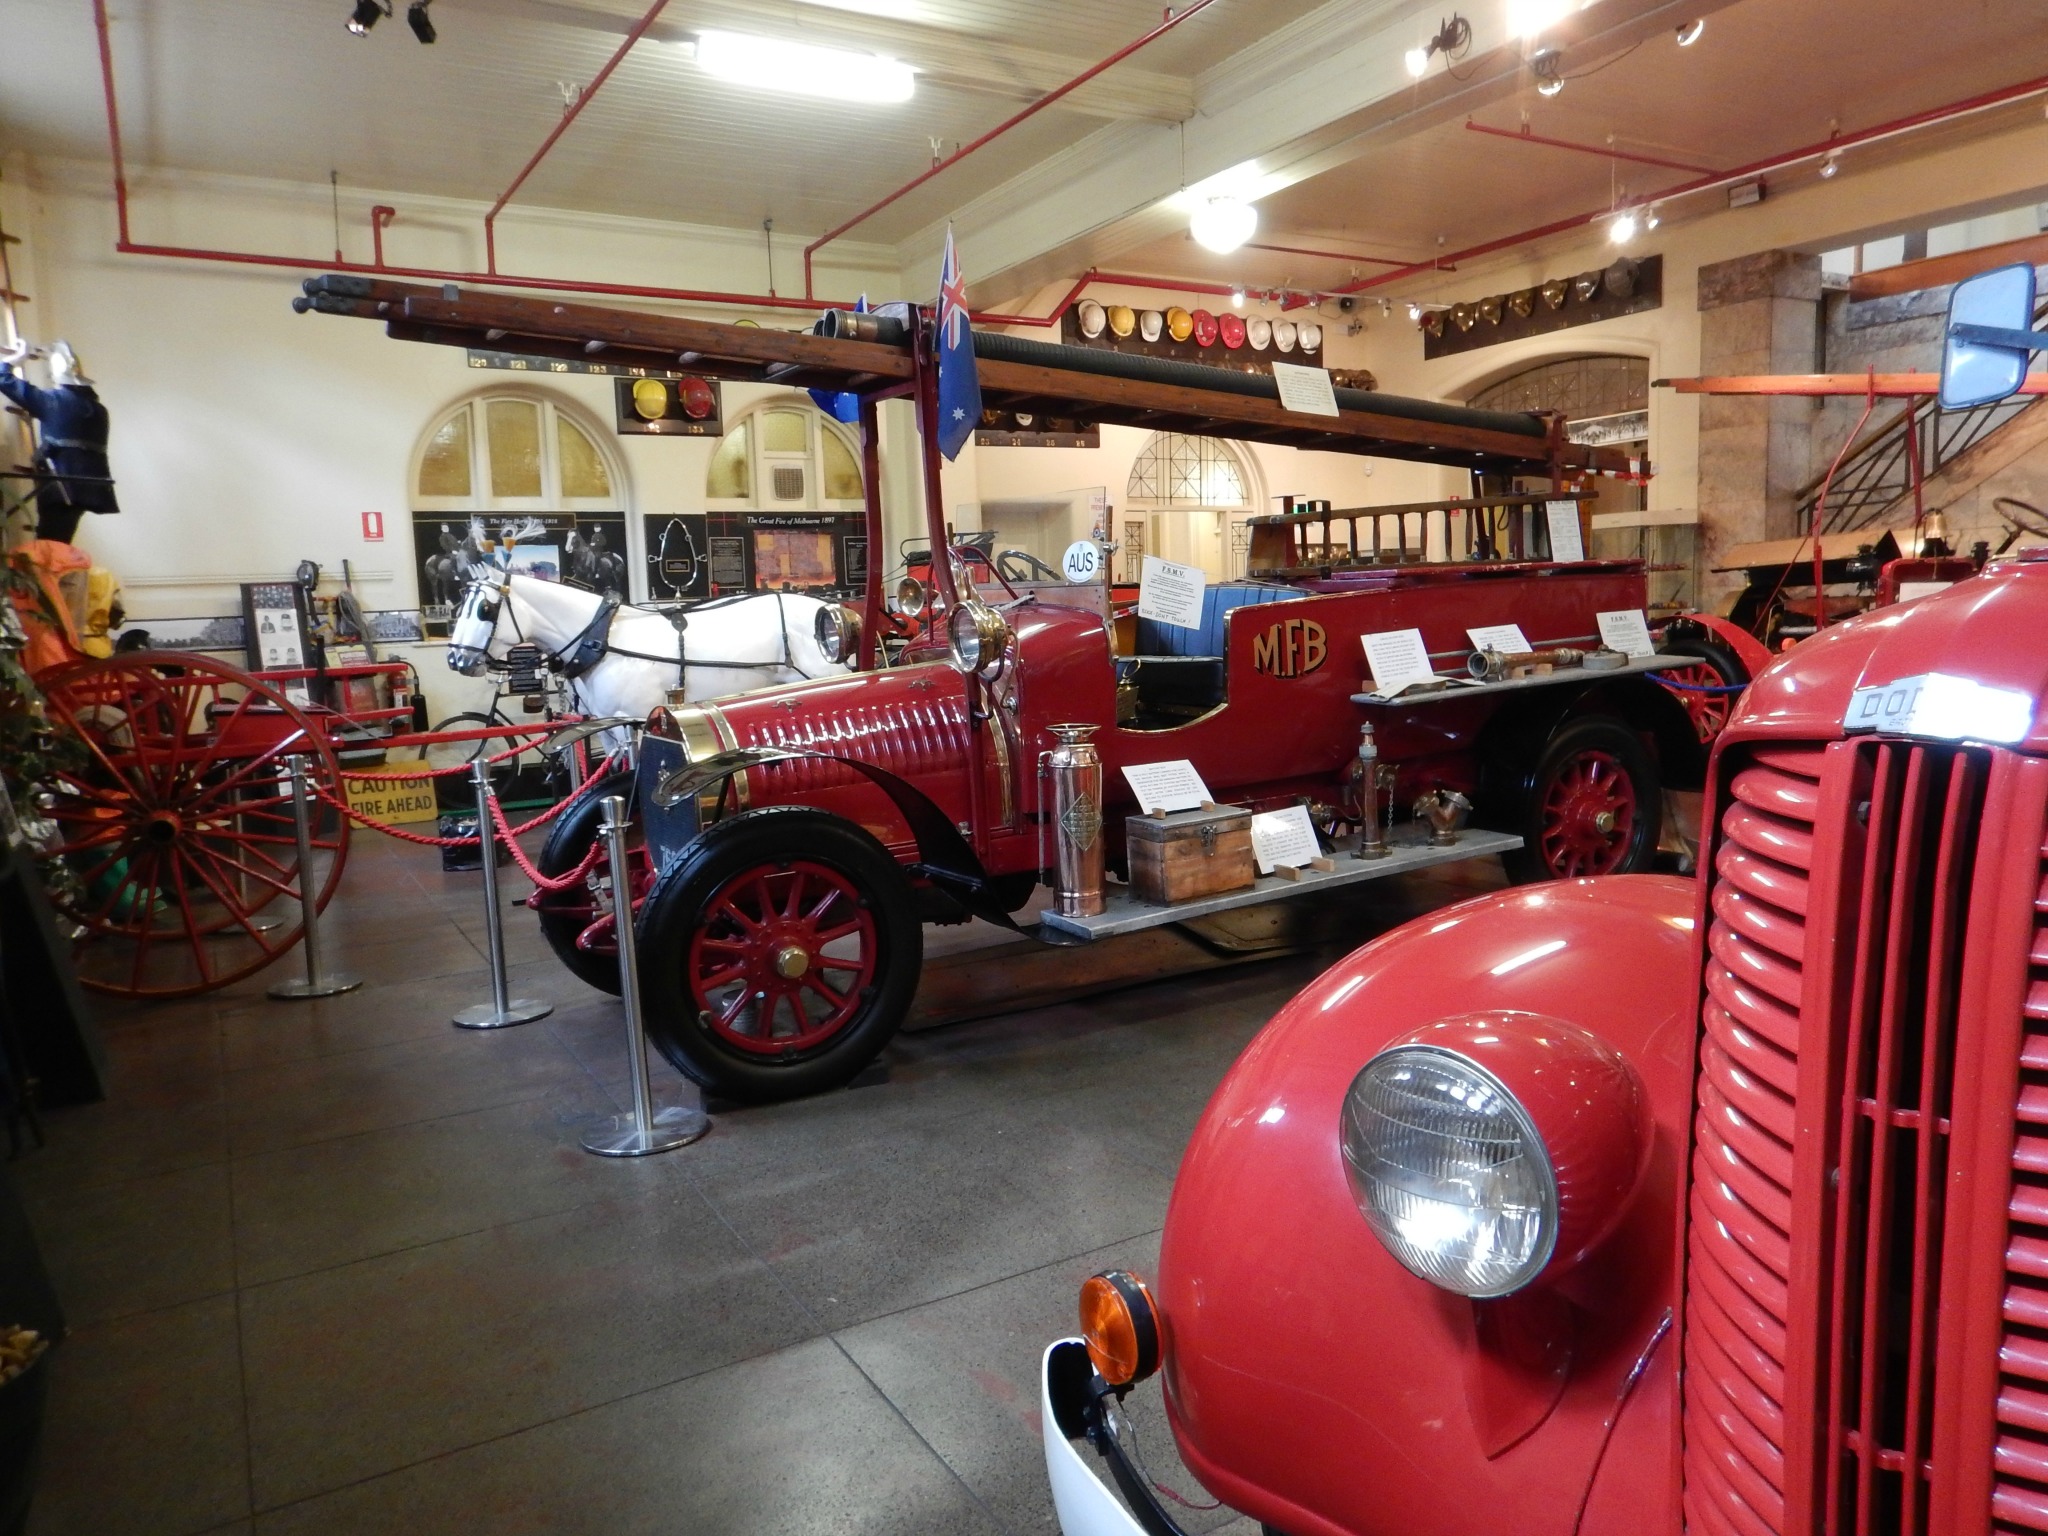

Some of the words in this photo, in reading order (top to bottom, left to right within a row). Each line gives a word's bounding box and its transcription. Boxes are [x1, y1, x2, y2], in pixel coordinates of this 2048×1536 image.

[589, 365, 607, 373] 123
[747, 516, 757, 524] The
[775, 517, 786, 525] Fire
[787, 517, 794, 525] of
[794, 517, 820, 525] Melbourne
[821, 516, 835, 524] 1897
[1067, 551, 1094, 573] AUS
[348, 779, 430, 795] CAUTION
[351, 800, 384, 816] FIRE
[386, 795, 432, 814] AHEAD
